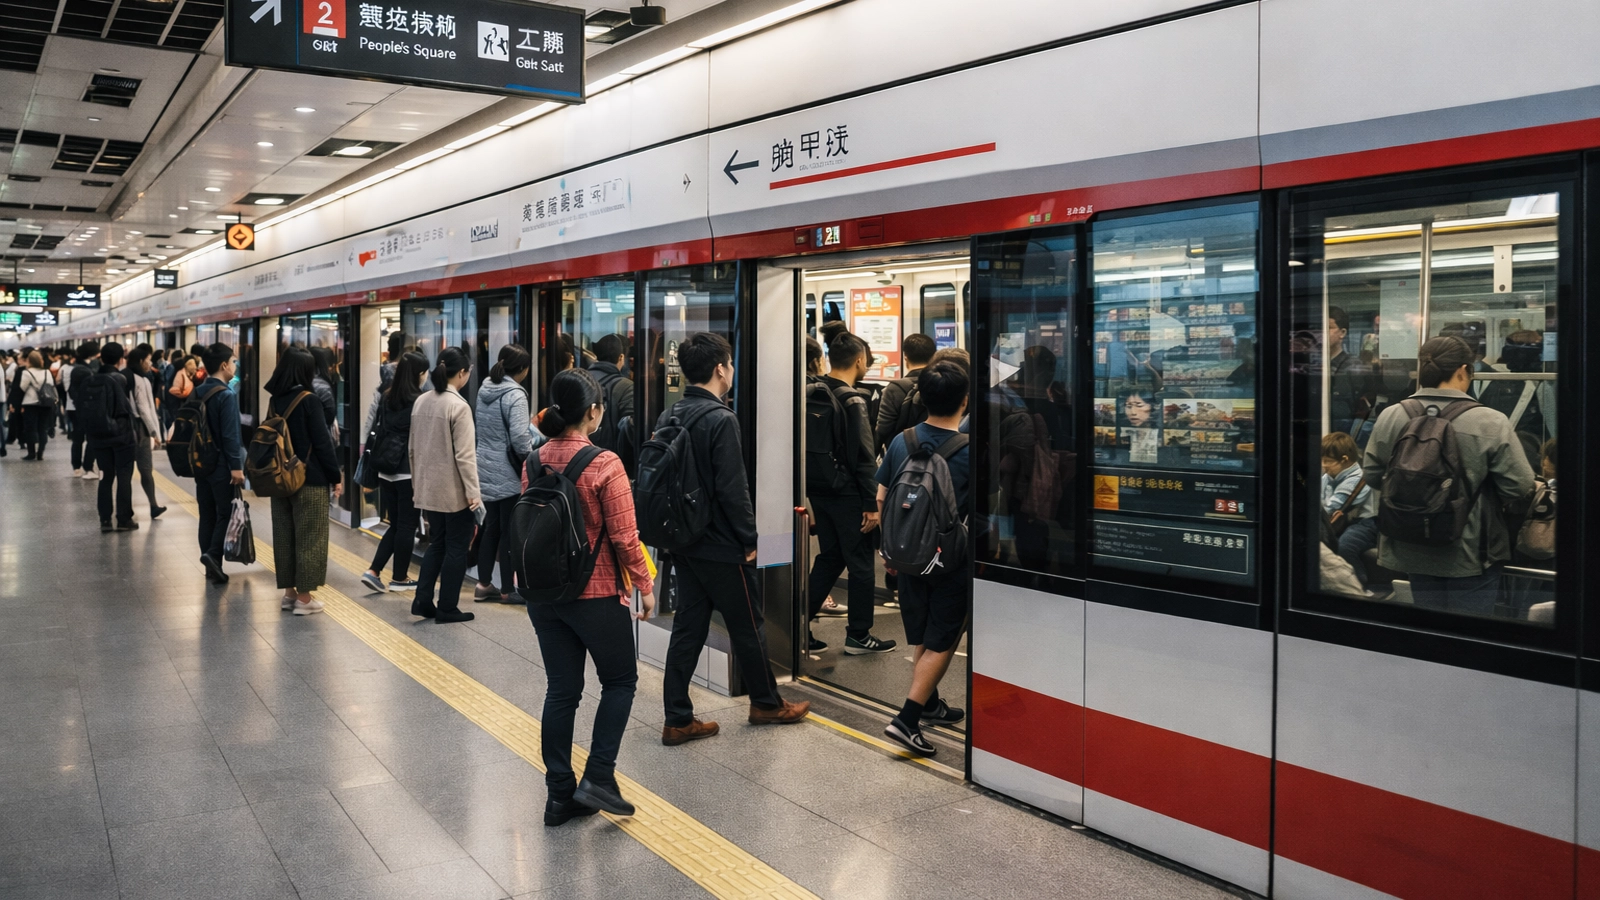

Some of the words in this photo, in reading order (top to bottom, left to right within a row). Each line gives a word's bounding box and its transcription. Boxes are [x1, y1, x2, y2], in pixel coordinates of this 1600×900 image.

[318, 1, 334, 25] 2
[359, 36, 410, 55] People's
[413, 43, 457, 60] Square
